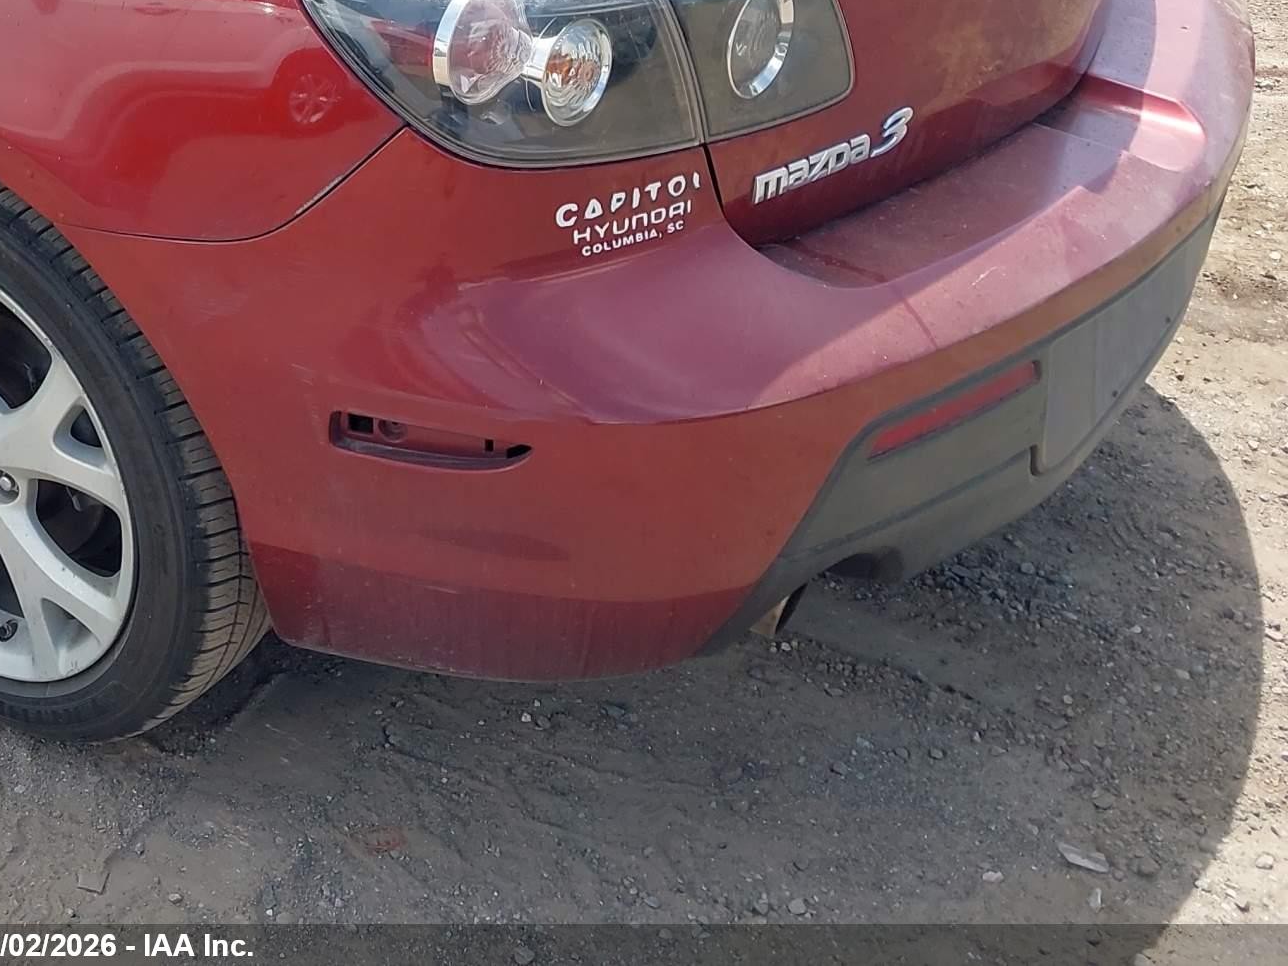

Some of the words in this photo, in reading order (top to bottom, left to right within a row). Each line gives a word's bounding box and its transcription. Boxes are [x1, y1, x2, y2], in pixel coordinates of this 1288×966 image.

[573, 199, 692, 245] HYUNDAI
[582, 228, 663, 256] COLUMBIA,
[667, 220, 684, 234] SC
